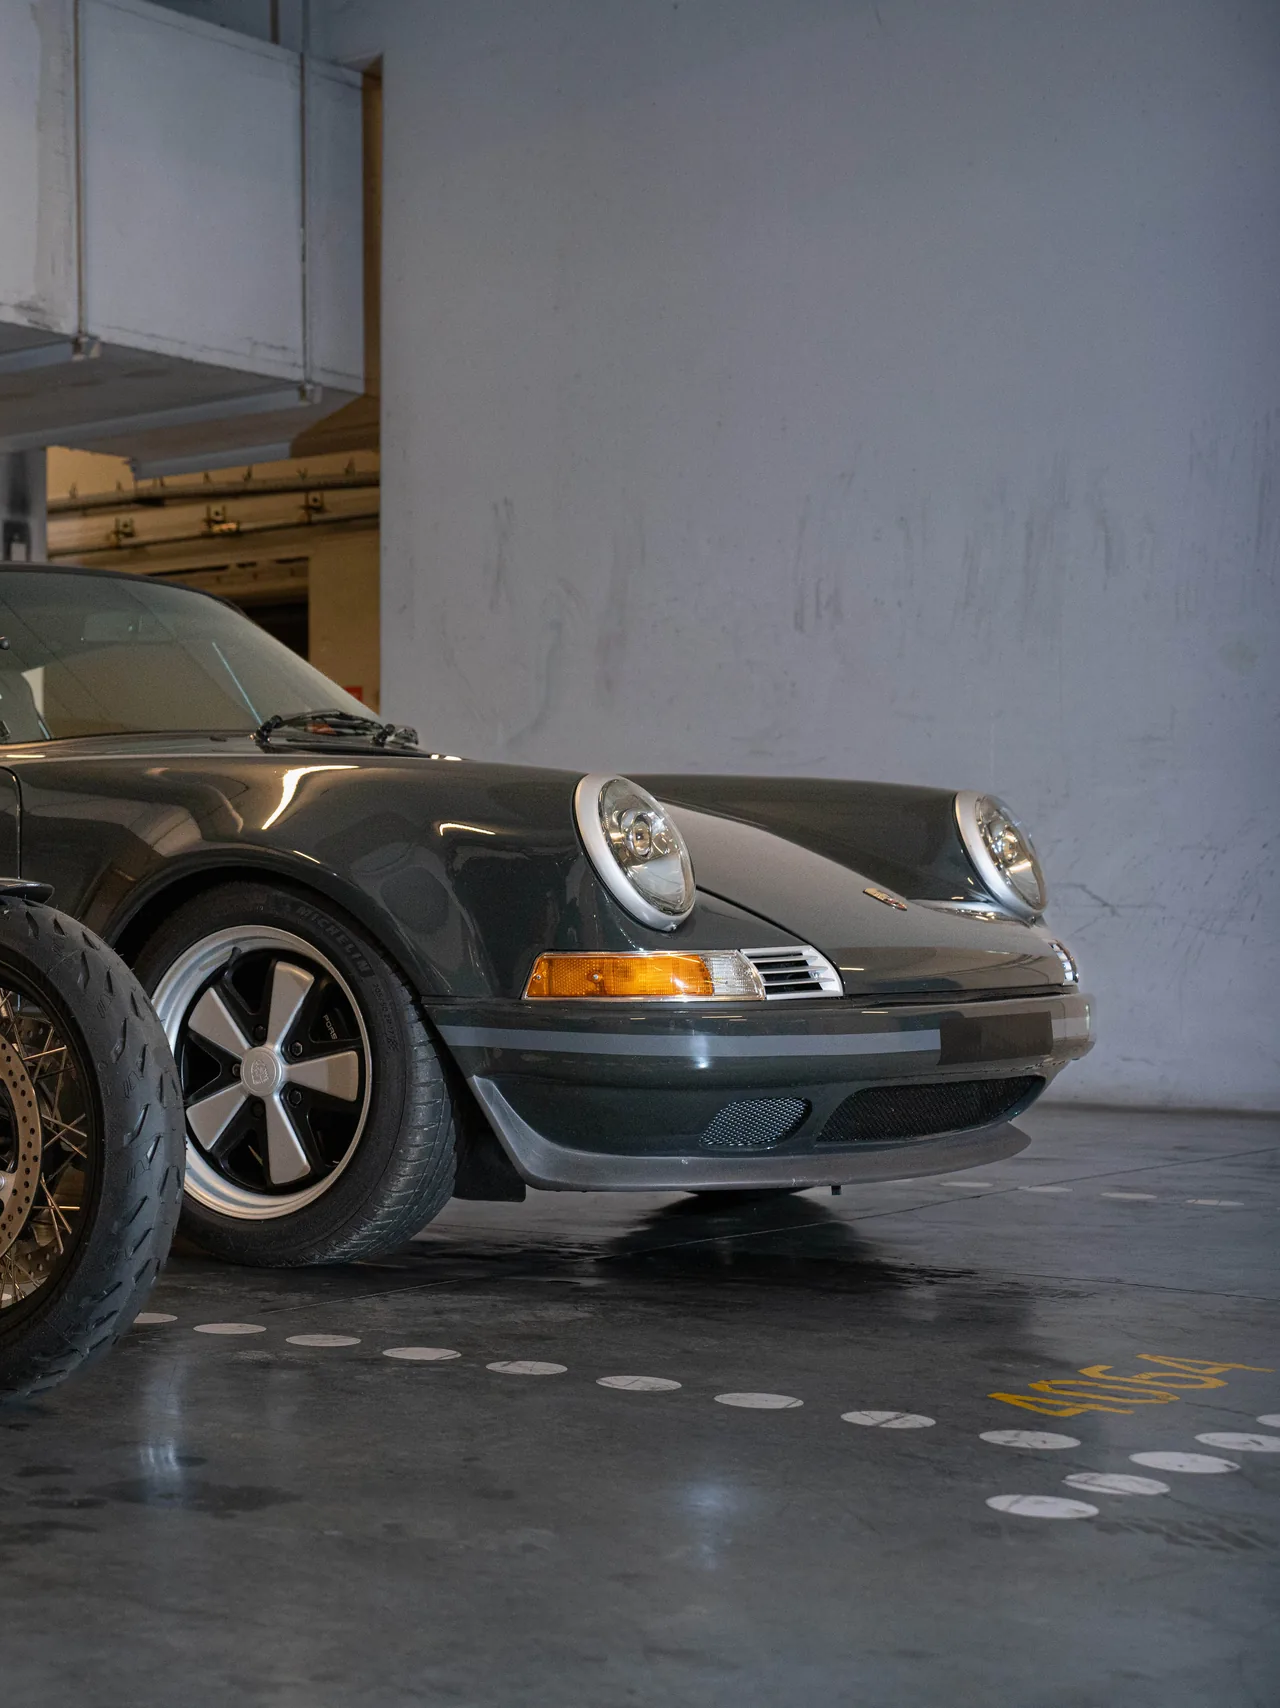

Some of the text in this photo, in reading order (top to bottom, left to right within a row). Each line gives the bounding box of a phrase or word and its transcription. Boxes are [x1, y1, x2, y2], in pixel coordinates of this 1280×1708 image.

[296, 906, 372, 973] MICHELIN
[322, 1014, 338, 1040] PORS
[987, 1353, 1275, 1417] 4064
